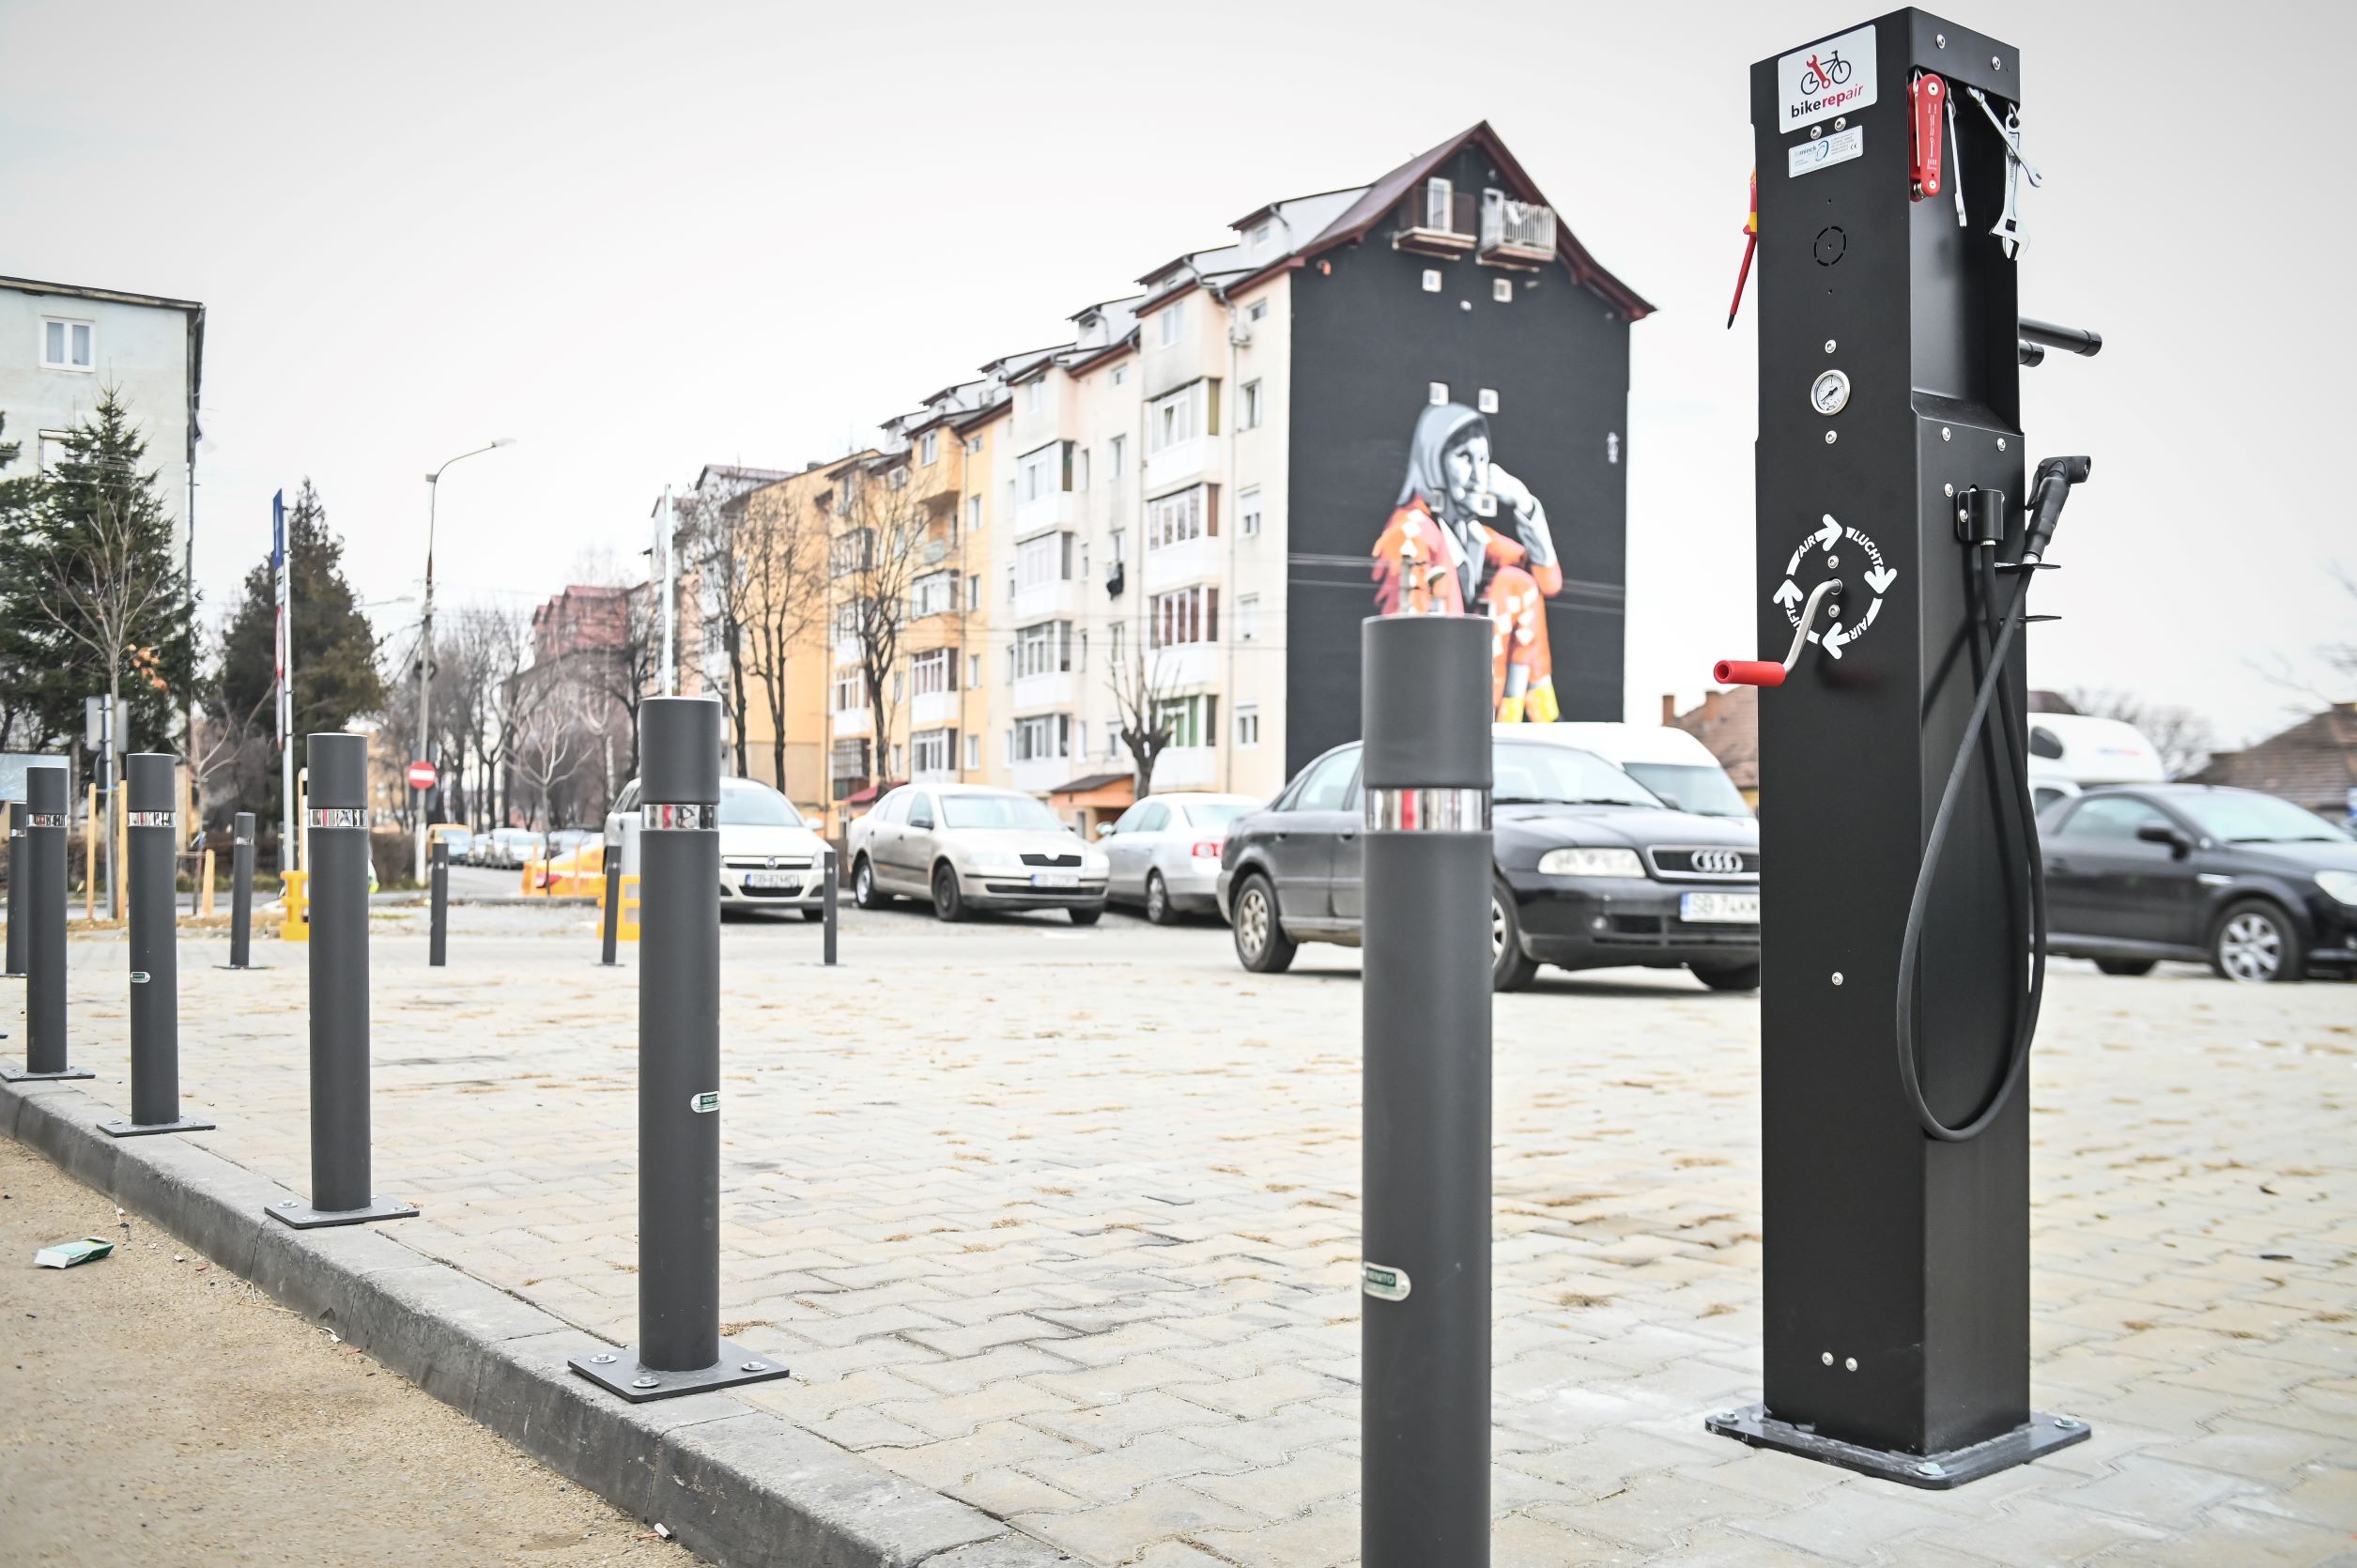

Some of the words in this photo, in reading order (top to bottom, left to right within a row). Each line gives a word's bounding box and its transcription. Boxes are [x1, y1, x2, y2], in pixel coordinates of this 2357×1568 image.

[1791, 83, 1864, 118] bikerepair
[1798, 534, 1817, 559] AIR
[1852, 530, 1884, 567] LUCHT
[1785, 608, 1803, 632] UFT
[1848, 617, 1869, 641] AIR
